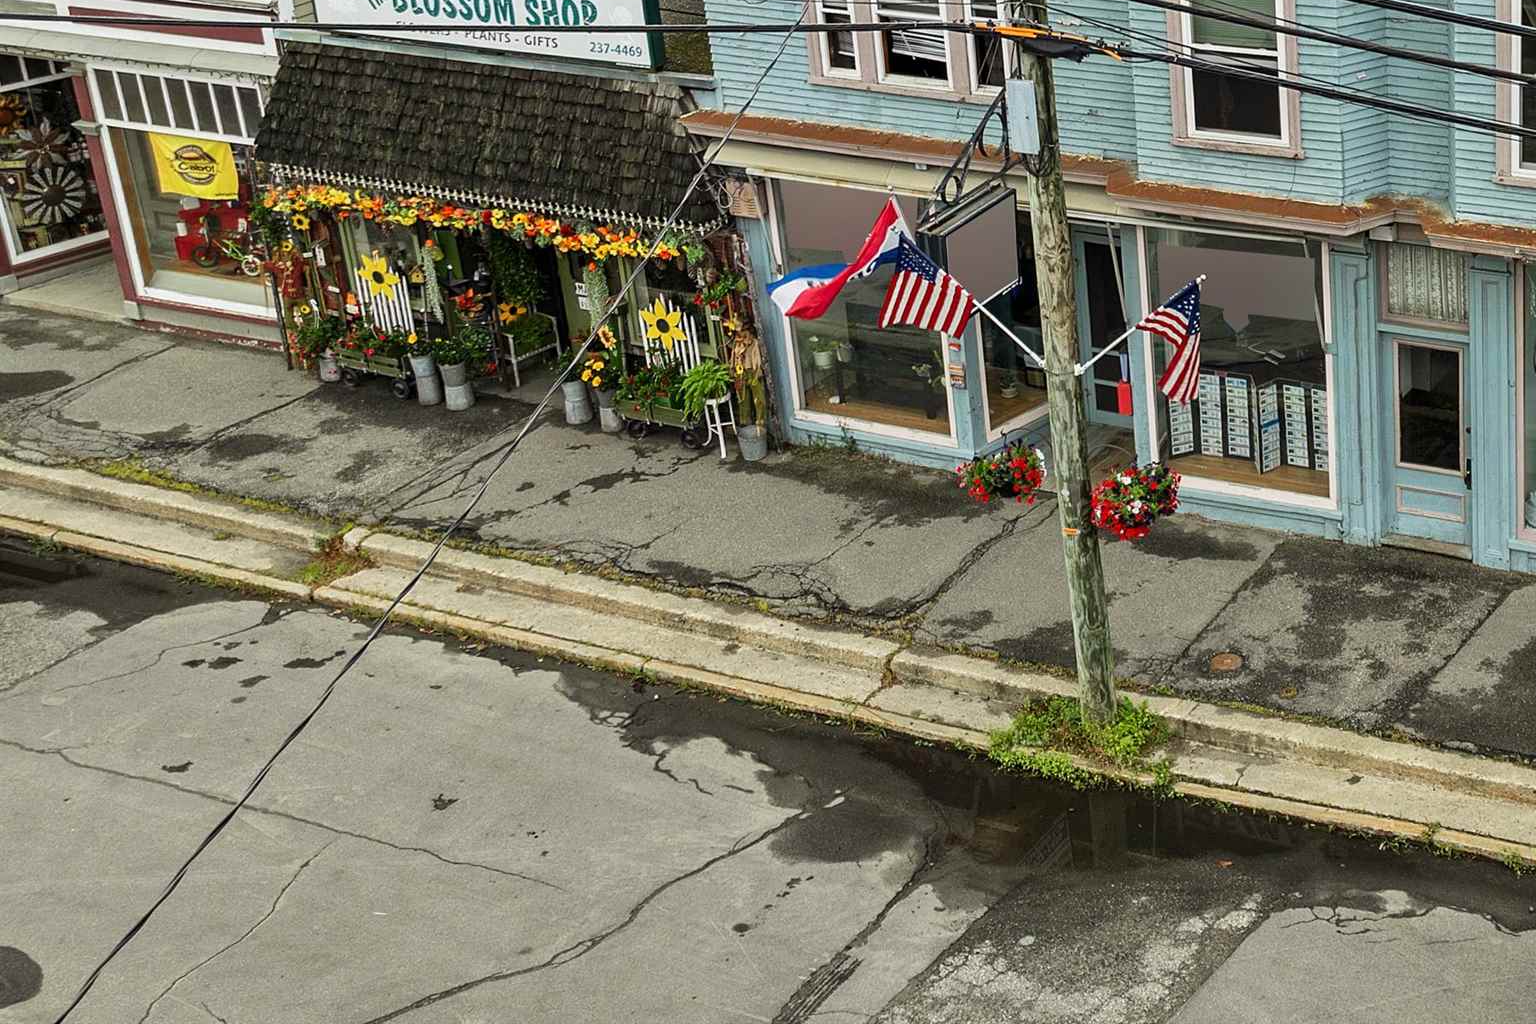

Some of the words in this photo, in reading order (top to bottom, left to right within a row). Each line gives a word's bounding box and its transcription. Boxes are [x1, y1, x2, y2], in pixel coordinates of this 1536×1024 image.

[465, 29, 511, 44] PLANTS
[524, 34, 559, 49] GIFTS
[589, 41, 643, 58] 237-4469
